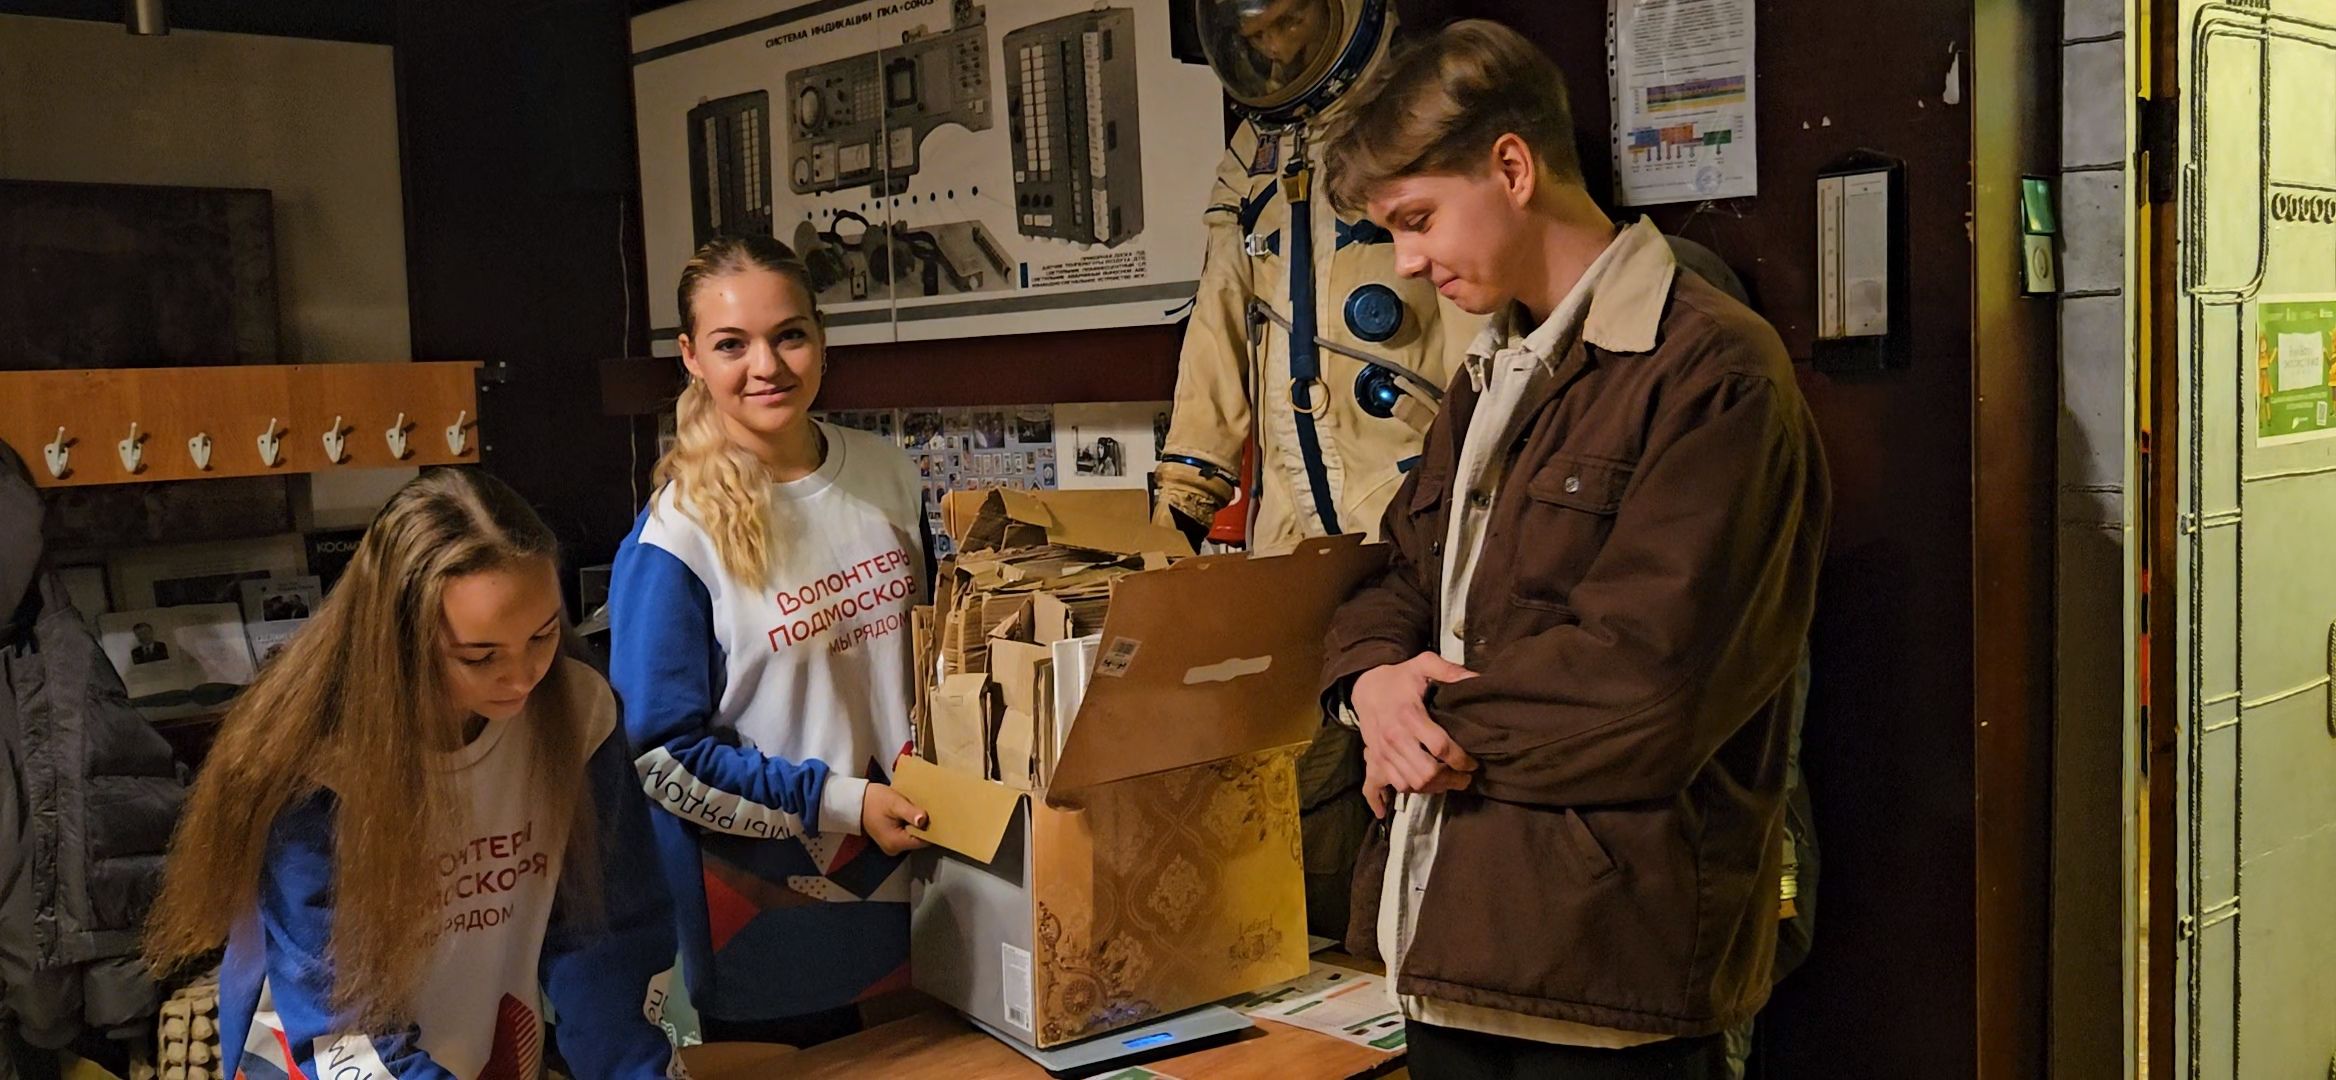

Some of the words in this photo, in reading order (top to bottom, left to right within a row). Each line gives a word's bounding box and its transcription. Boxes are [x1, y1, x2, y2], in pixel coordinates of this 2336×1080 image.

[765, 29, 808, 48] СИСТЕМА
[811, 12, 872, 36] ИНДИКАЦИИ
[877, 5, 899, 18] ПКА
[317, 541, 360, 553] КОСМО
[768, 575, 916, 652] ПОДМОСКОВ
[828, 634, 853, 656] МЫ
[853, 610, 911, 644] РЯДОМ
[646, 761, 737, 830] РЯДОМ
